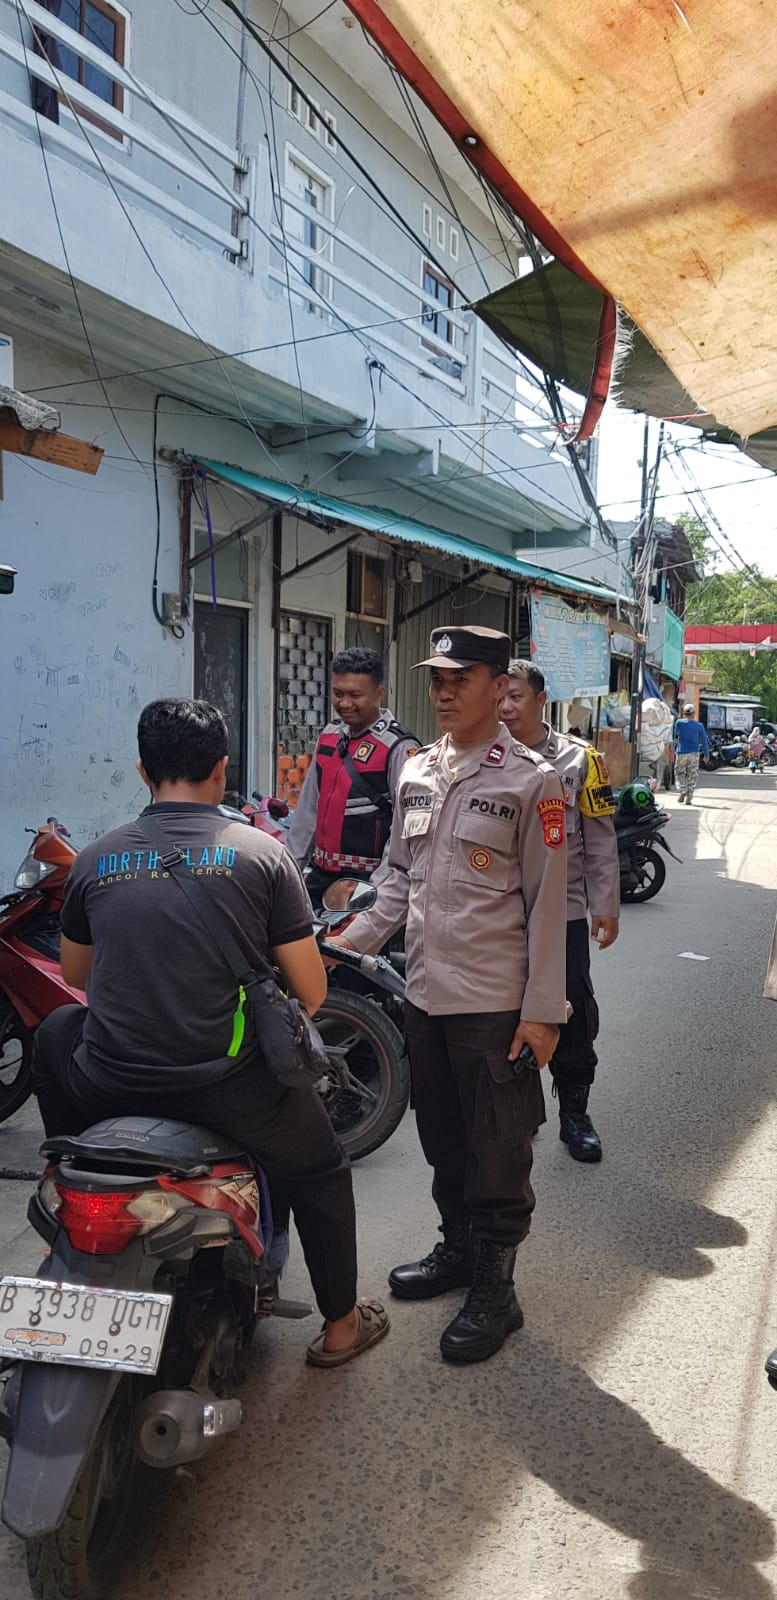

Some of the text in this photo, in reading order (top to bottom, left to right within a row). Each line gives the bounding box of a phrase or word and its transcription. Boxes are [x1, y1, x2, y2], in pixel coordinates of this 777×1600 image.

[468, 798, 516, 821] POLRI
[98, 847, 237, 878] NORTH LAND
[98, 867, 233, 888] Ancol Reence
[0, 1285, 164, 1332] B 3938 UGH
